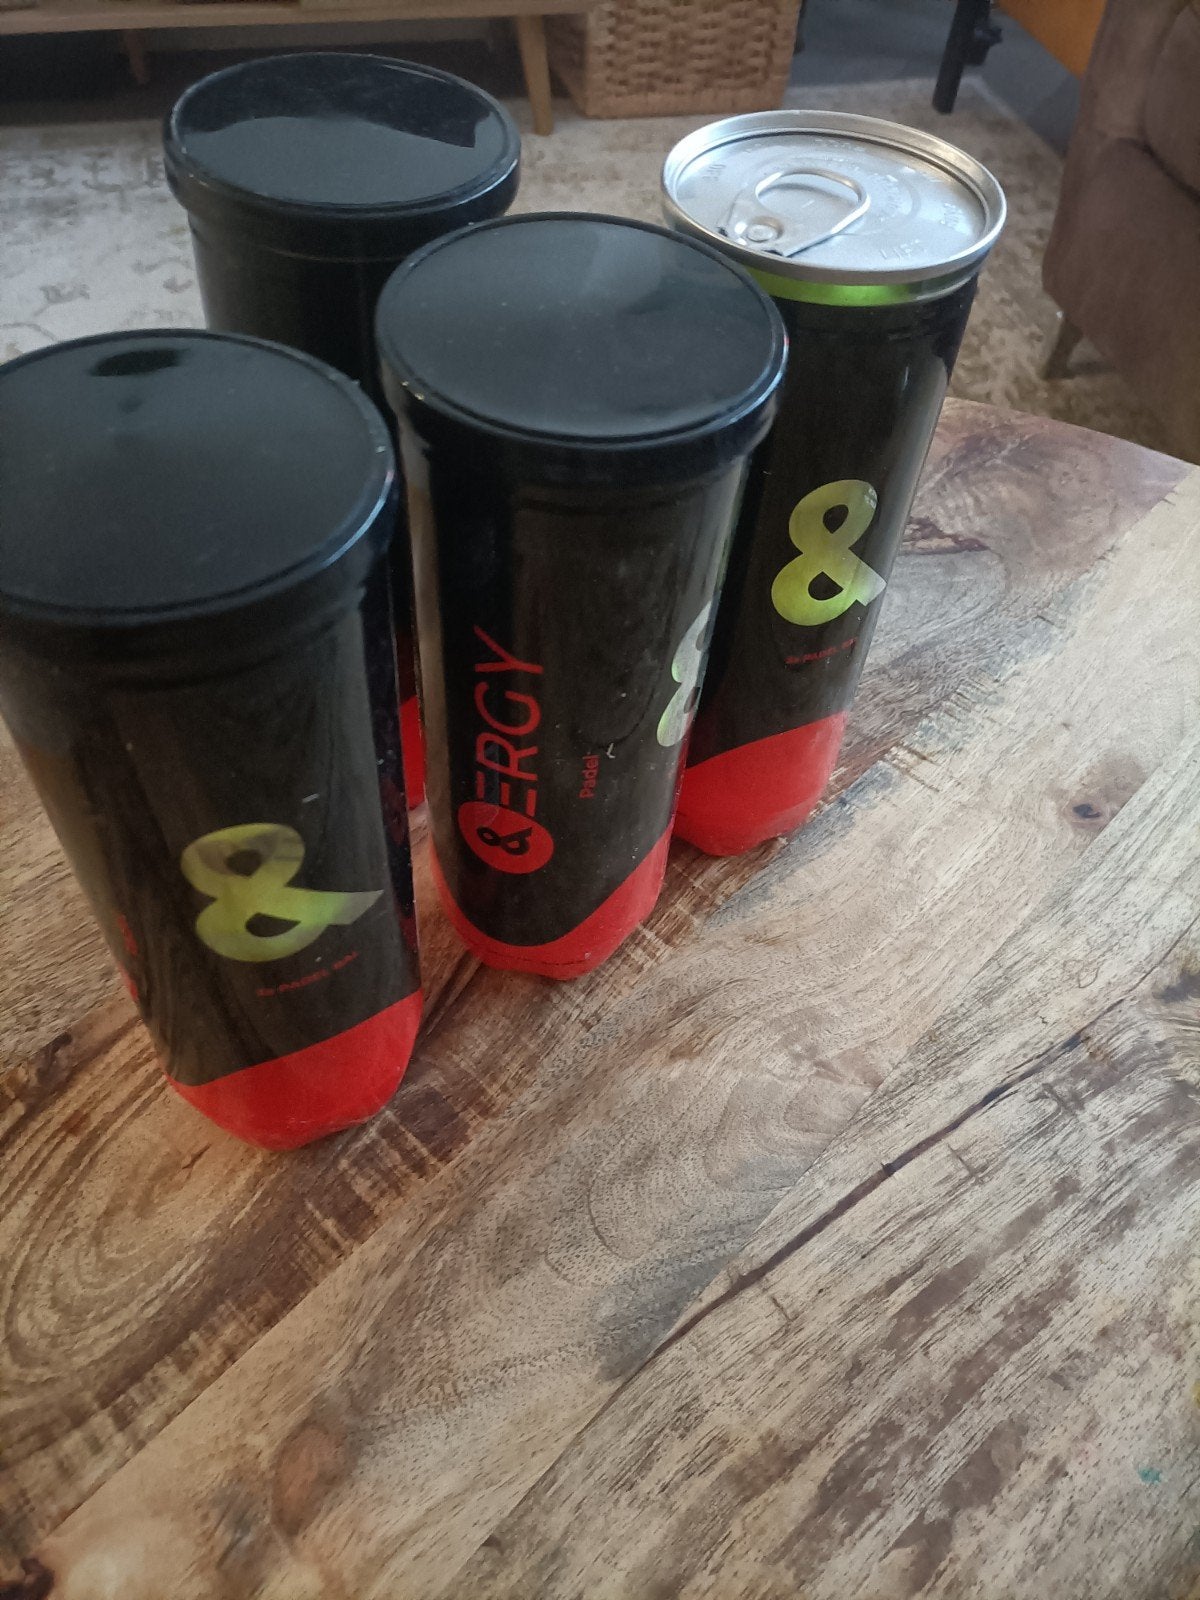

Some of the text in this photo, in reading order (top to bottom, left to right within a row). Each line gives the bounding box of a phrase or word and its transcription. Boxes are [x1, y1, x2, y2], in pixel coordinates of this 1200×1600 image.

[771, 479, 887, 626] &
[578, 753, 600, 800] Padel
[181, 823, 384, 962] &
